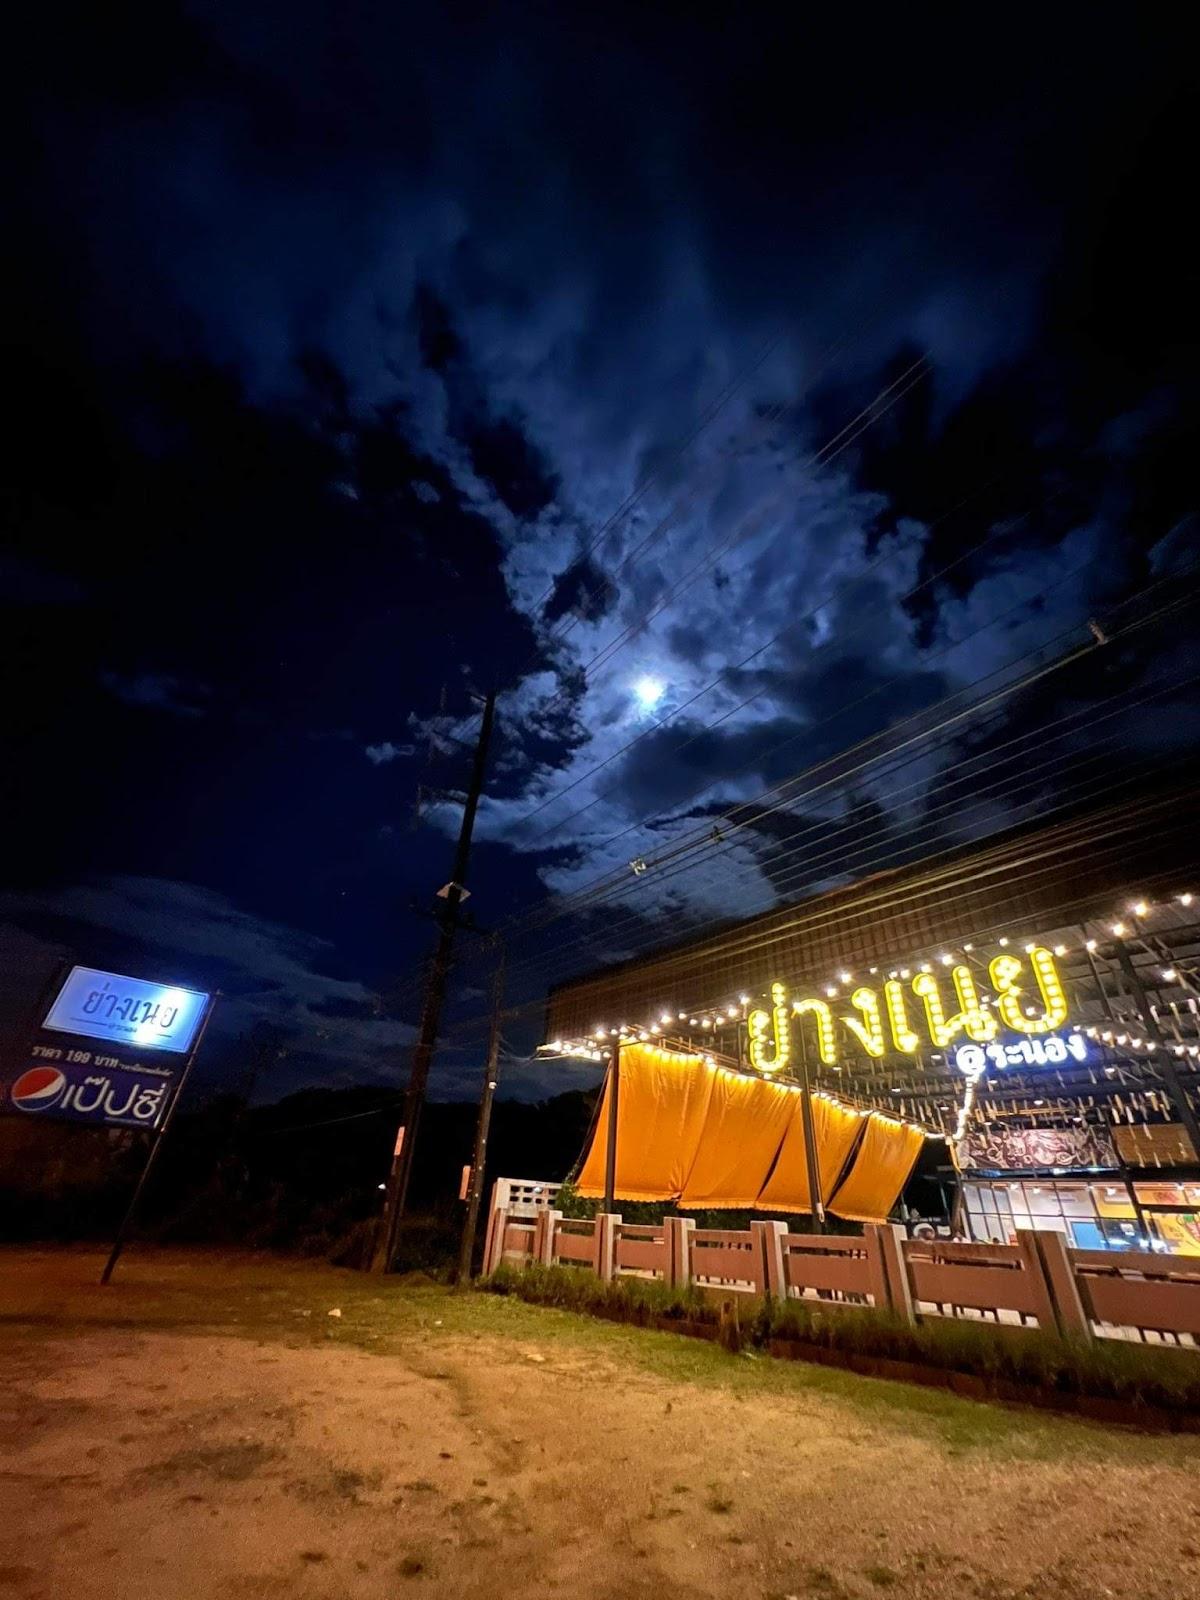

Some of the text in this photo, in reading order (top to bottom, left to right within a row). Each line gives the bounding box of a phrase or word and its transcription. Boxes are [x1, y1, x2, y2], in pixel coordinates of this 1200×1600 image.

[82, 982, 179, 1029] ย่างเนย
[748, 946, 1068, 1072] ย่างเนย
[65, 1049, 93, 1064] 199
[94, 1055, 120, 1068] บาท
[60, 1076, 167, 1119] เป๊ปซี่
